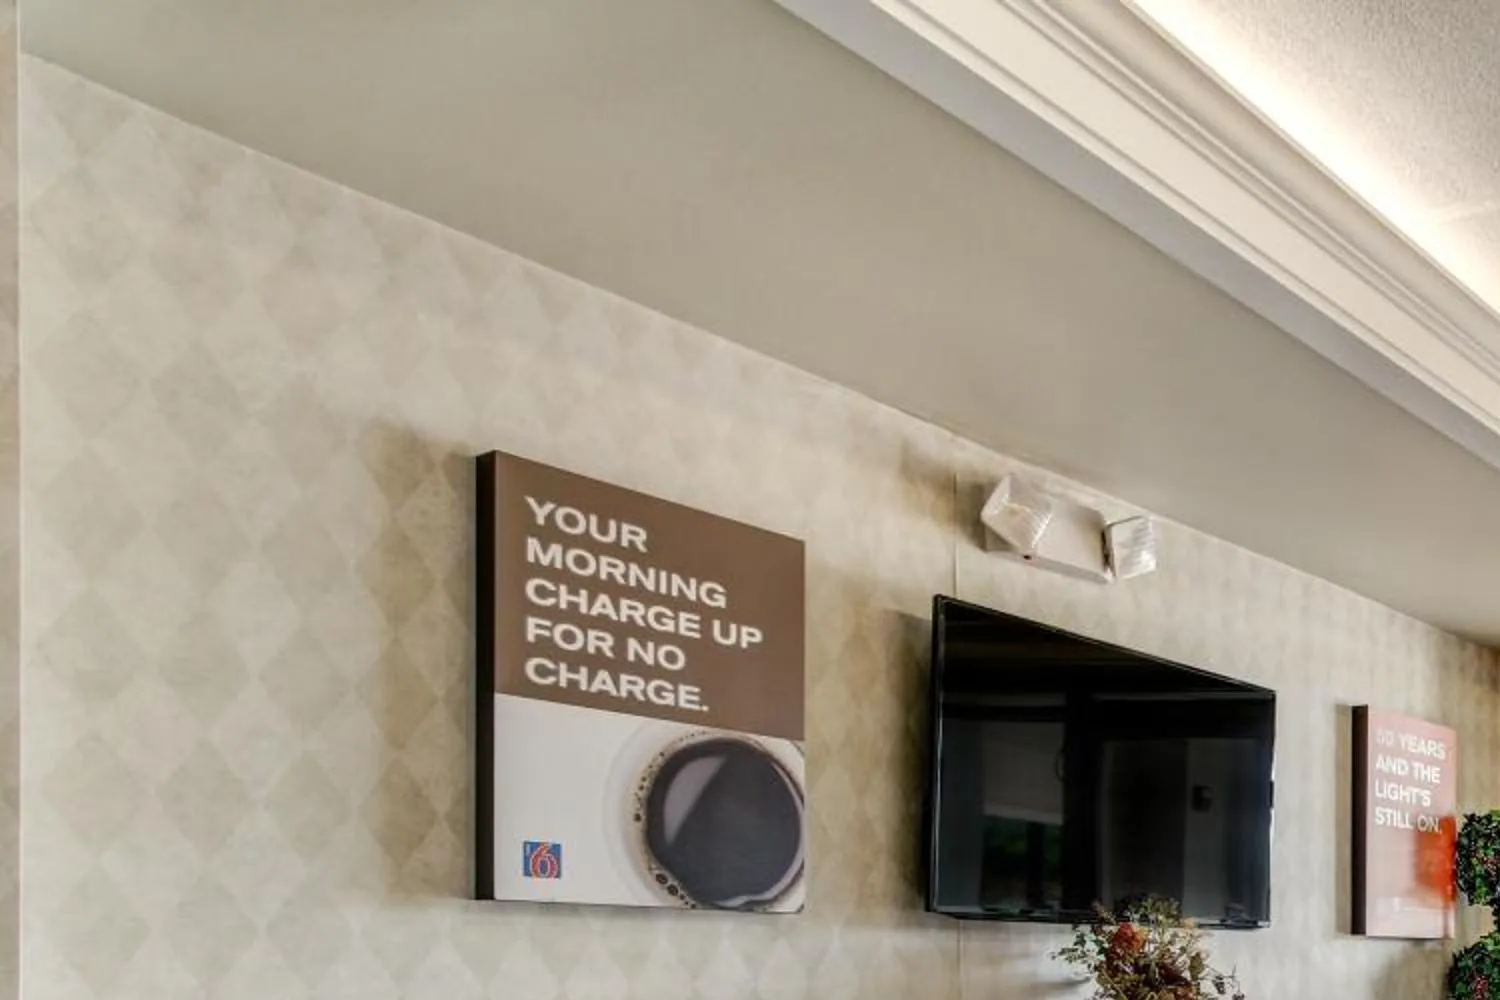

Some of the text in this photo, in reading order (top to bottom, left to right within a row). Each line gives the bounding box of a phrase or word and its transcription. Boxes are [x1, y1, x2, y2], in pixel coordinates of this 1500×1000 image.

[524, 495, 648, 553] YOUR
[527, 536, 727, 609] MORNING
[524, 577, 763, 650] CHARGE UP
[526, 616, 686, 671] FOR NO
[524, 656, 709, 712] CHARGE.
[1376, 754, 1441, 784] AND THE
[1398, 732, 1446, 760] YEARS
[1375, 806, 1414, 831] STILL
